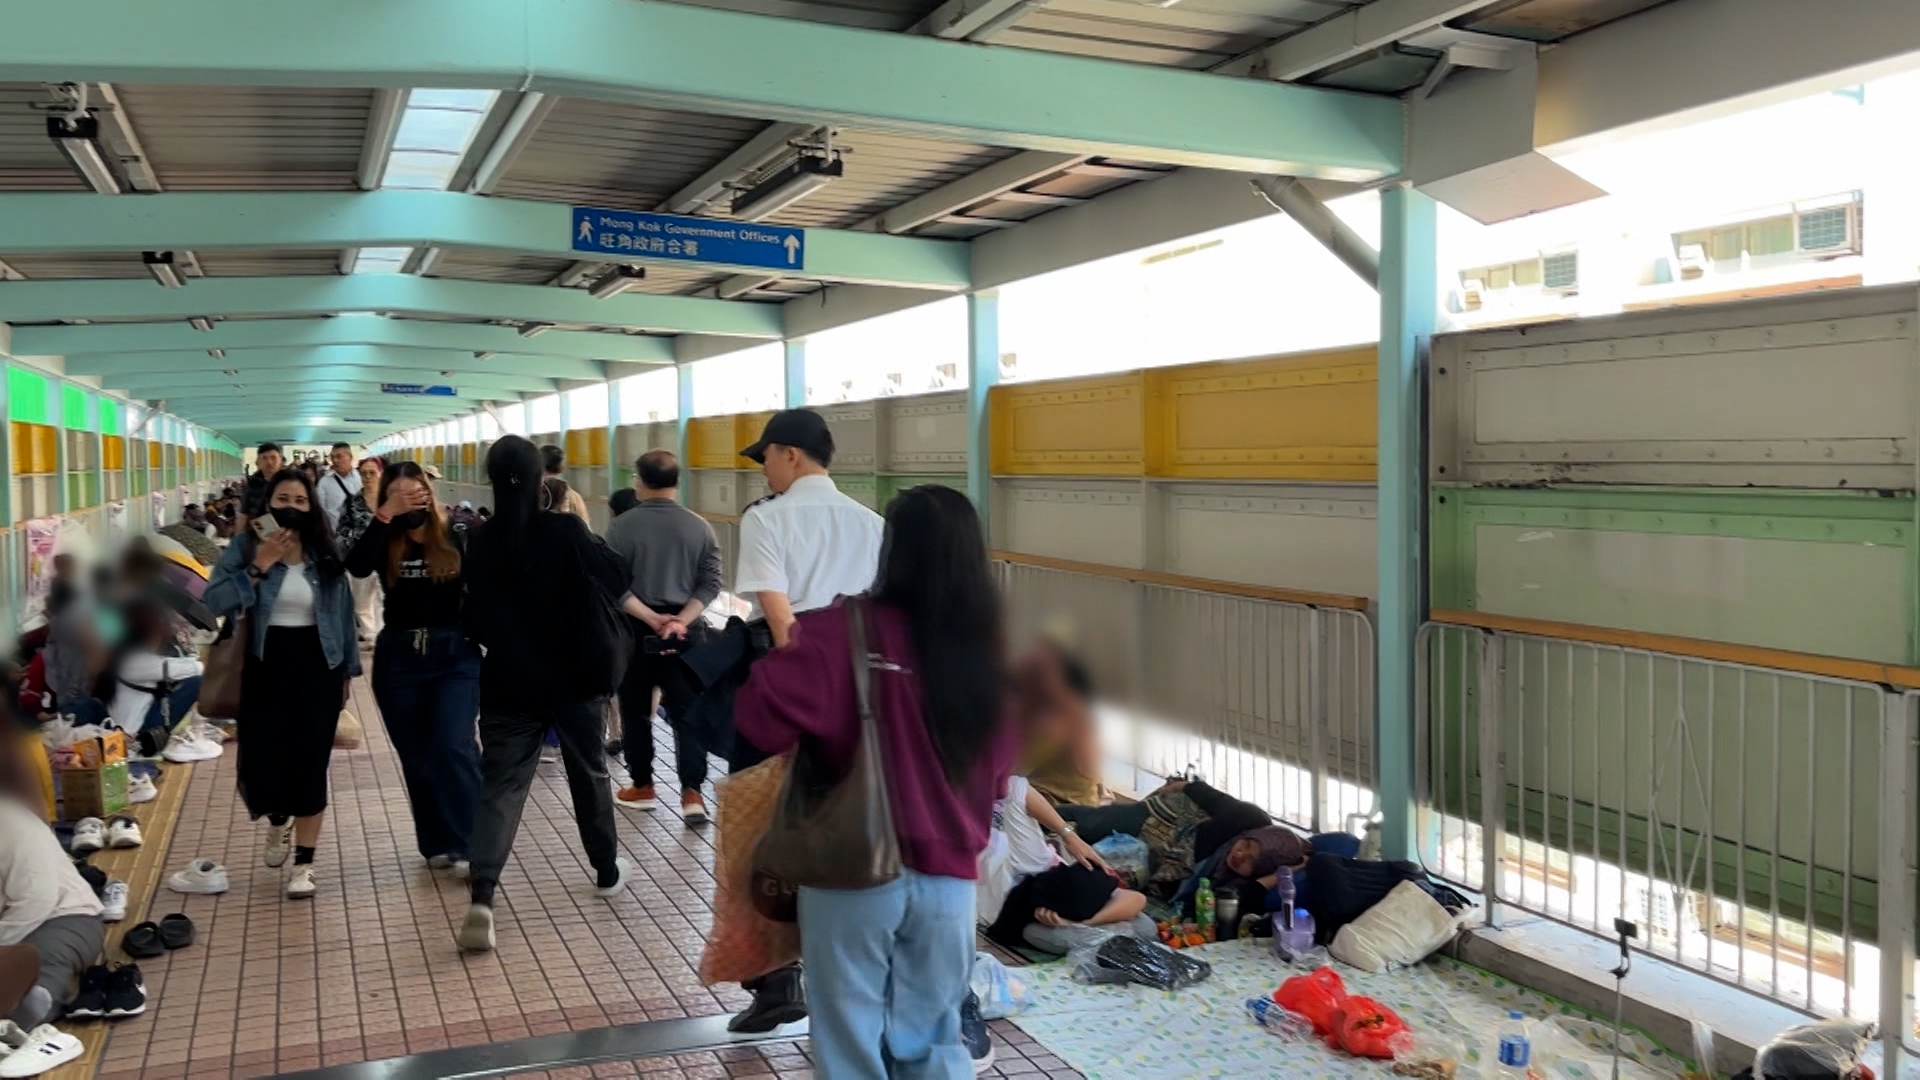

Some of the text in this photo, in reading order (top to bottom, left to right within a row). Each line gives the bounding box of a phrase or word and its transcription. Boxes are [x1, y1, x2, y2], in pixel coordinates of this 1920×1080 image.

[599, 216, 781, 244] Mong Kok Government Offices
[599, 233, 698, 256] 旺角政府合署
